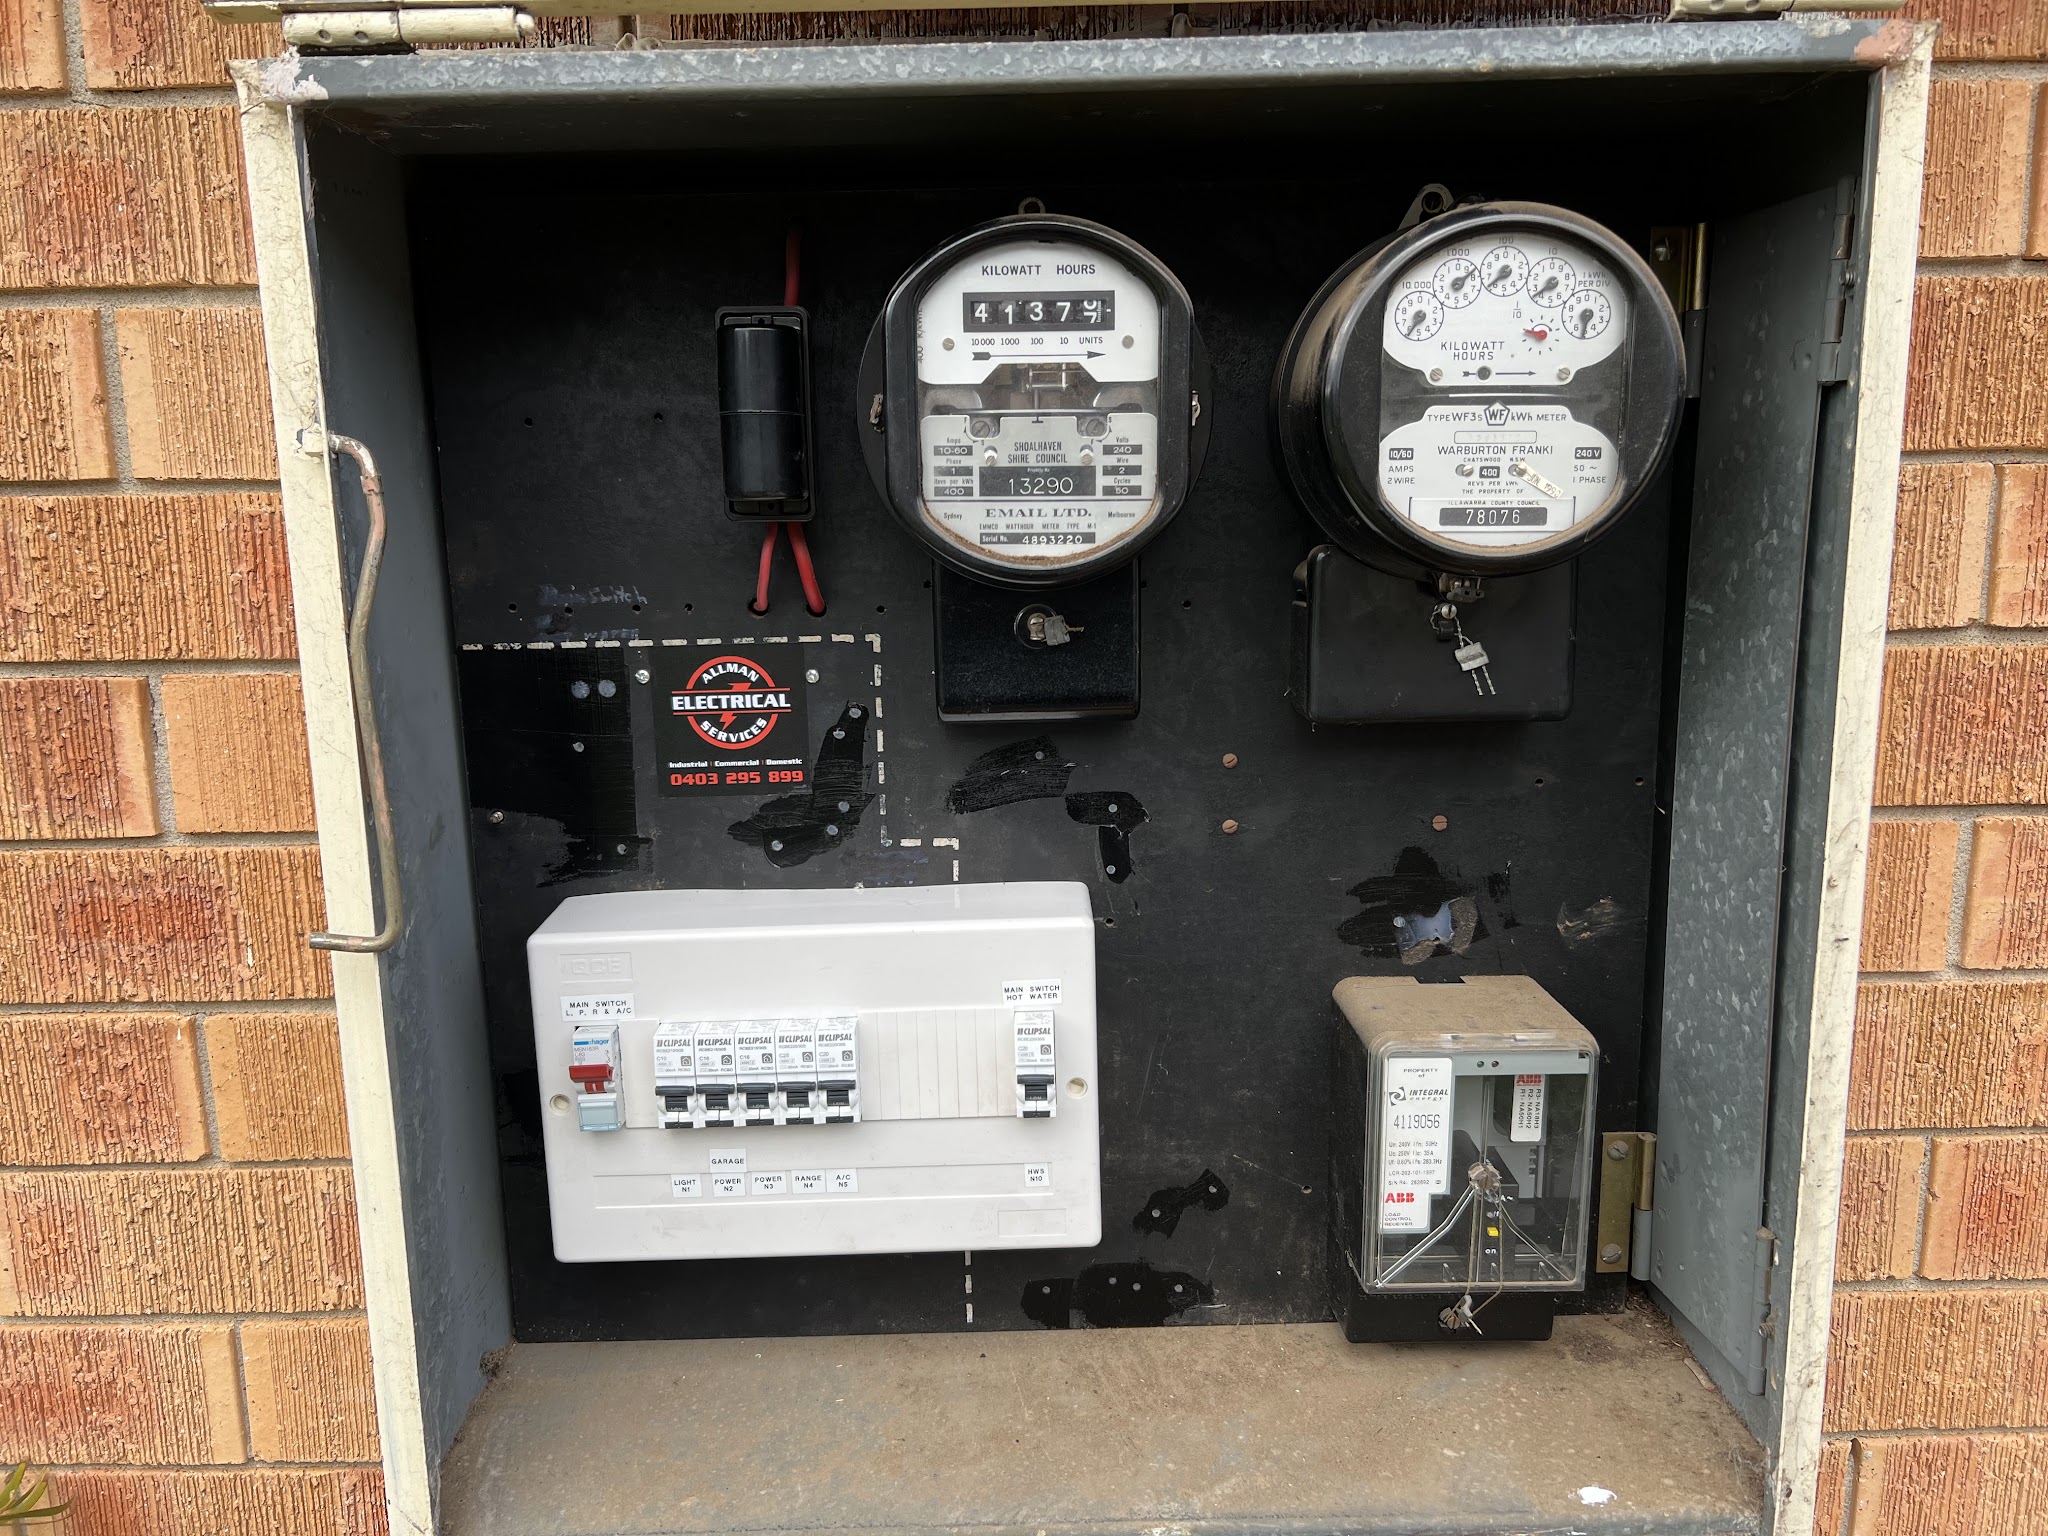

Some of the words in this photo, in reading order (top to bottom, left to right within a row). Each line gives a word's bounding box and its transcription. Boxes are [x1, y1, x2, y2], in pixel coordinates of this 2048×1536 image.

[982, 265, 1042, 276] KILOWATT
[1056, 264, 1096, 275] HOURS
[1000, 338, 1020, 346] 1000
[1078, 336, 1103, 344] UNITS
[1440, 341, 1505, 350] KILOWATT
[1453, 352, 1494, 360] HOURS
[1489, 409, 1506, 420] WF
[1511, 412, 1532, 421] kWh
[946, 437, 962, 445] Amps
[1014, 442, 1062, 452] SHOALHAVEN
[1113, 446, 1132, 454] 240
[1437, 446, 1506, 455] WARBURTON
[1512, 446, 1553, 454] FRANKI
[1008, 454, 1030, 464] SHIRE
[1036, 454, 1067, 463] COUNCIL
[1390, 450, 1411, 459] 10/60
[1482, 468, 1498, 476] 400
[1008, 477, 1073, 495] 13290
[985, 508, 1048, 518] EMAIL
[1052, 508, 1092, 517] LTD.
[1466, 509, 1520, 524] 78076
[1022, 535, 1082, 545] 4893220
[701, 663, 759, 684] ALLMAN
[672, 693, 791, 710] ELECTRICAL
[700, 718, 767, 742] SERVICES
[670, 773, 718, 786] 0403
[726, 772, 760, 784] 295
[768, 770, 803, 783] 899
[1030, 992, 1058, 1000] WATER
[704, 1038, 732, 1046] CLIPSAL
[785, 1035, 812, 1043] CLIPSAL
[1516, 1074, 1542, 1084] ABB
[1394, 1114, 1440, 1129] 4119056
[1385, 1192, 1415, 1203] ABB
